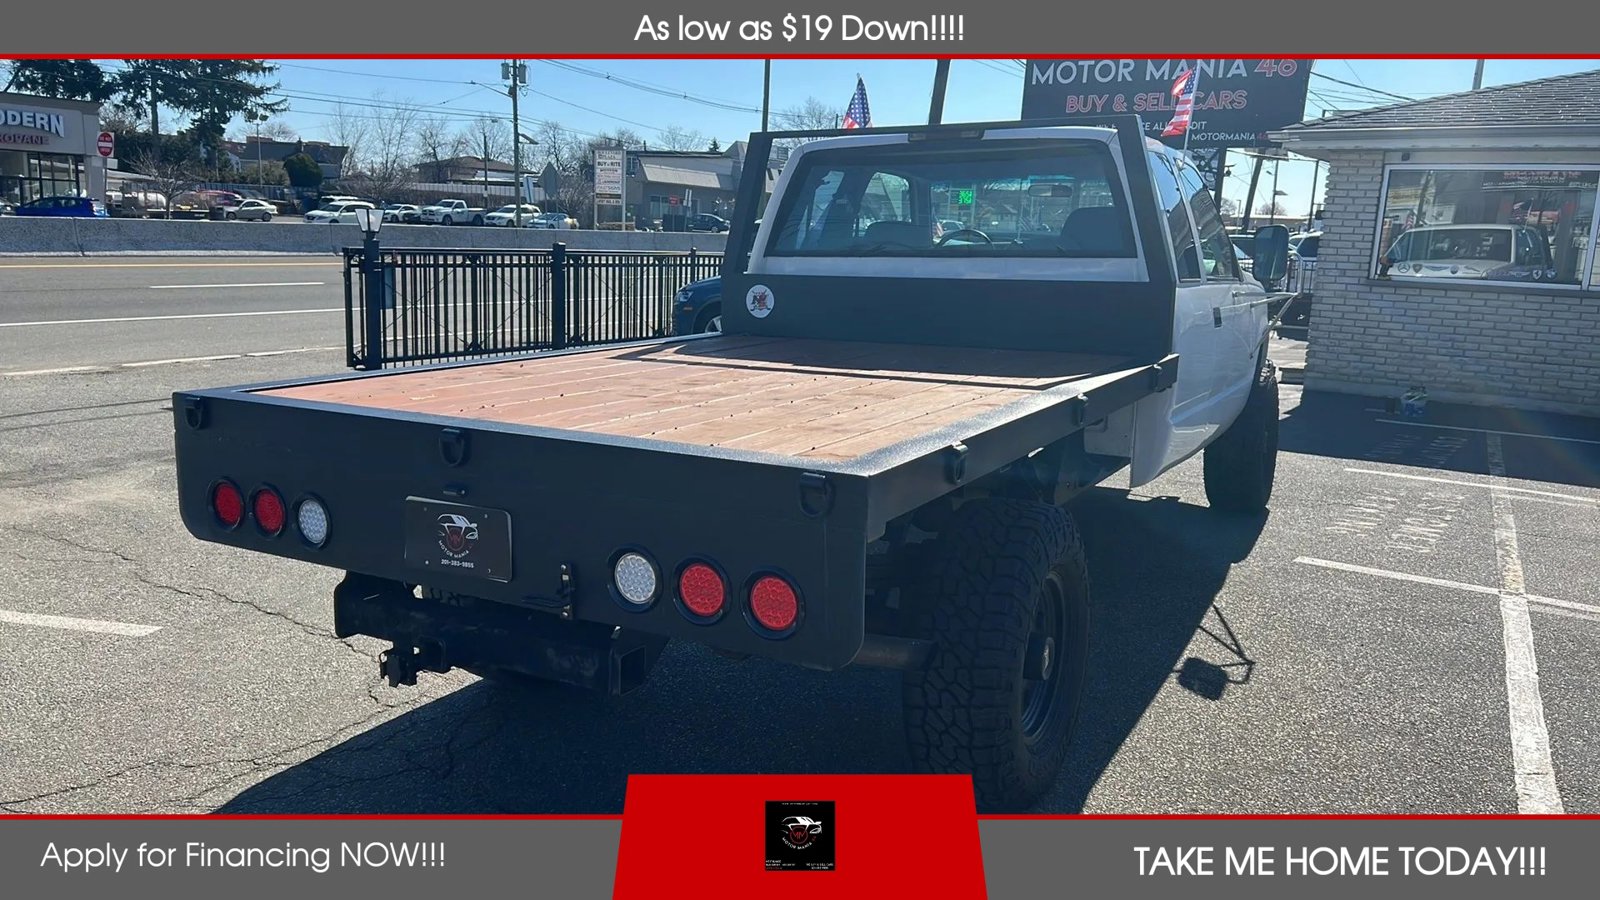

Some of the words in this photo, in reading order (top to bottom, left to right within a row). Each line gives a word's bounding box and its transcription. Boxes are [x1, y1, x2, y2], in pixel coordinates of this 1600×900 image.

[1032, 59, 1135, 85] MOTOR
[1145, 59, 1248, 80] MANIA
[1254, 59, 1298, 77] 46
[1065, 94, 1109, 113] BUY
[1112, 93, 1128, 113] &
[1133, 92, 1179, 111] SELL
[1192, 90, 1248, 110] CARS
